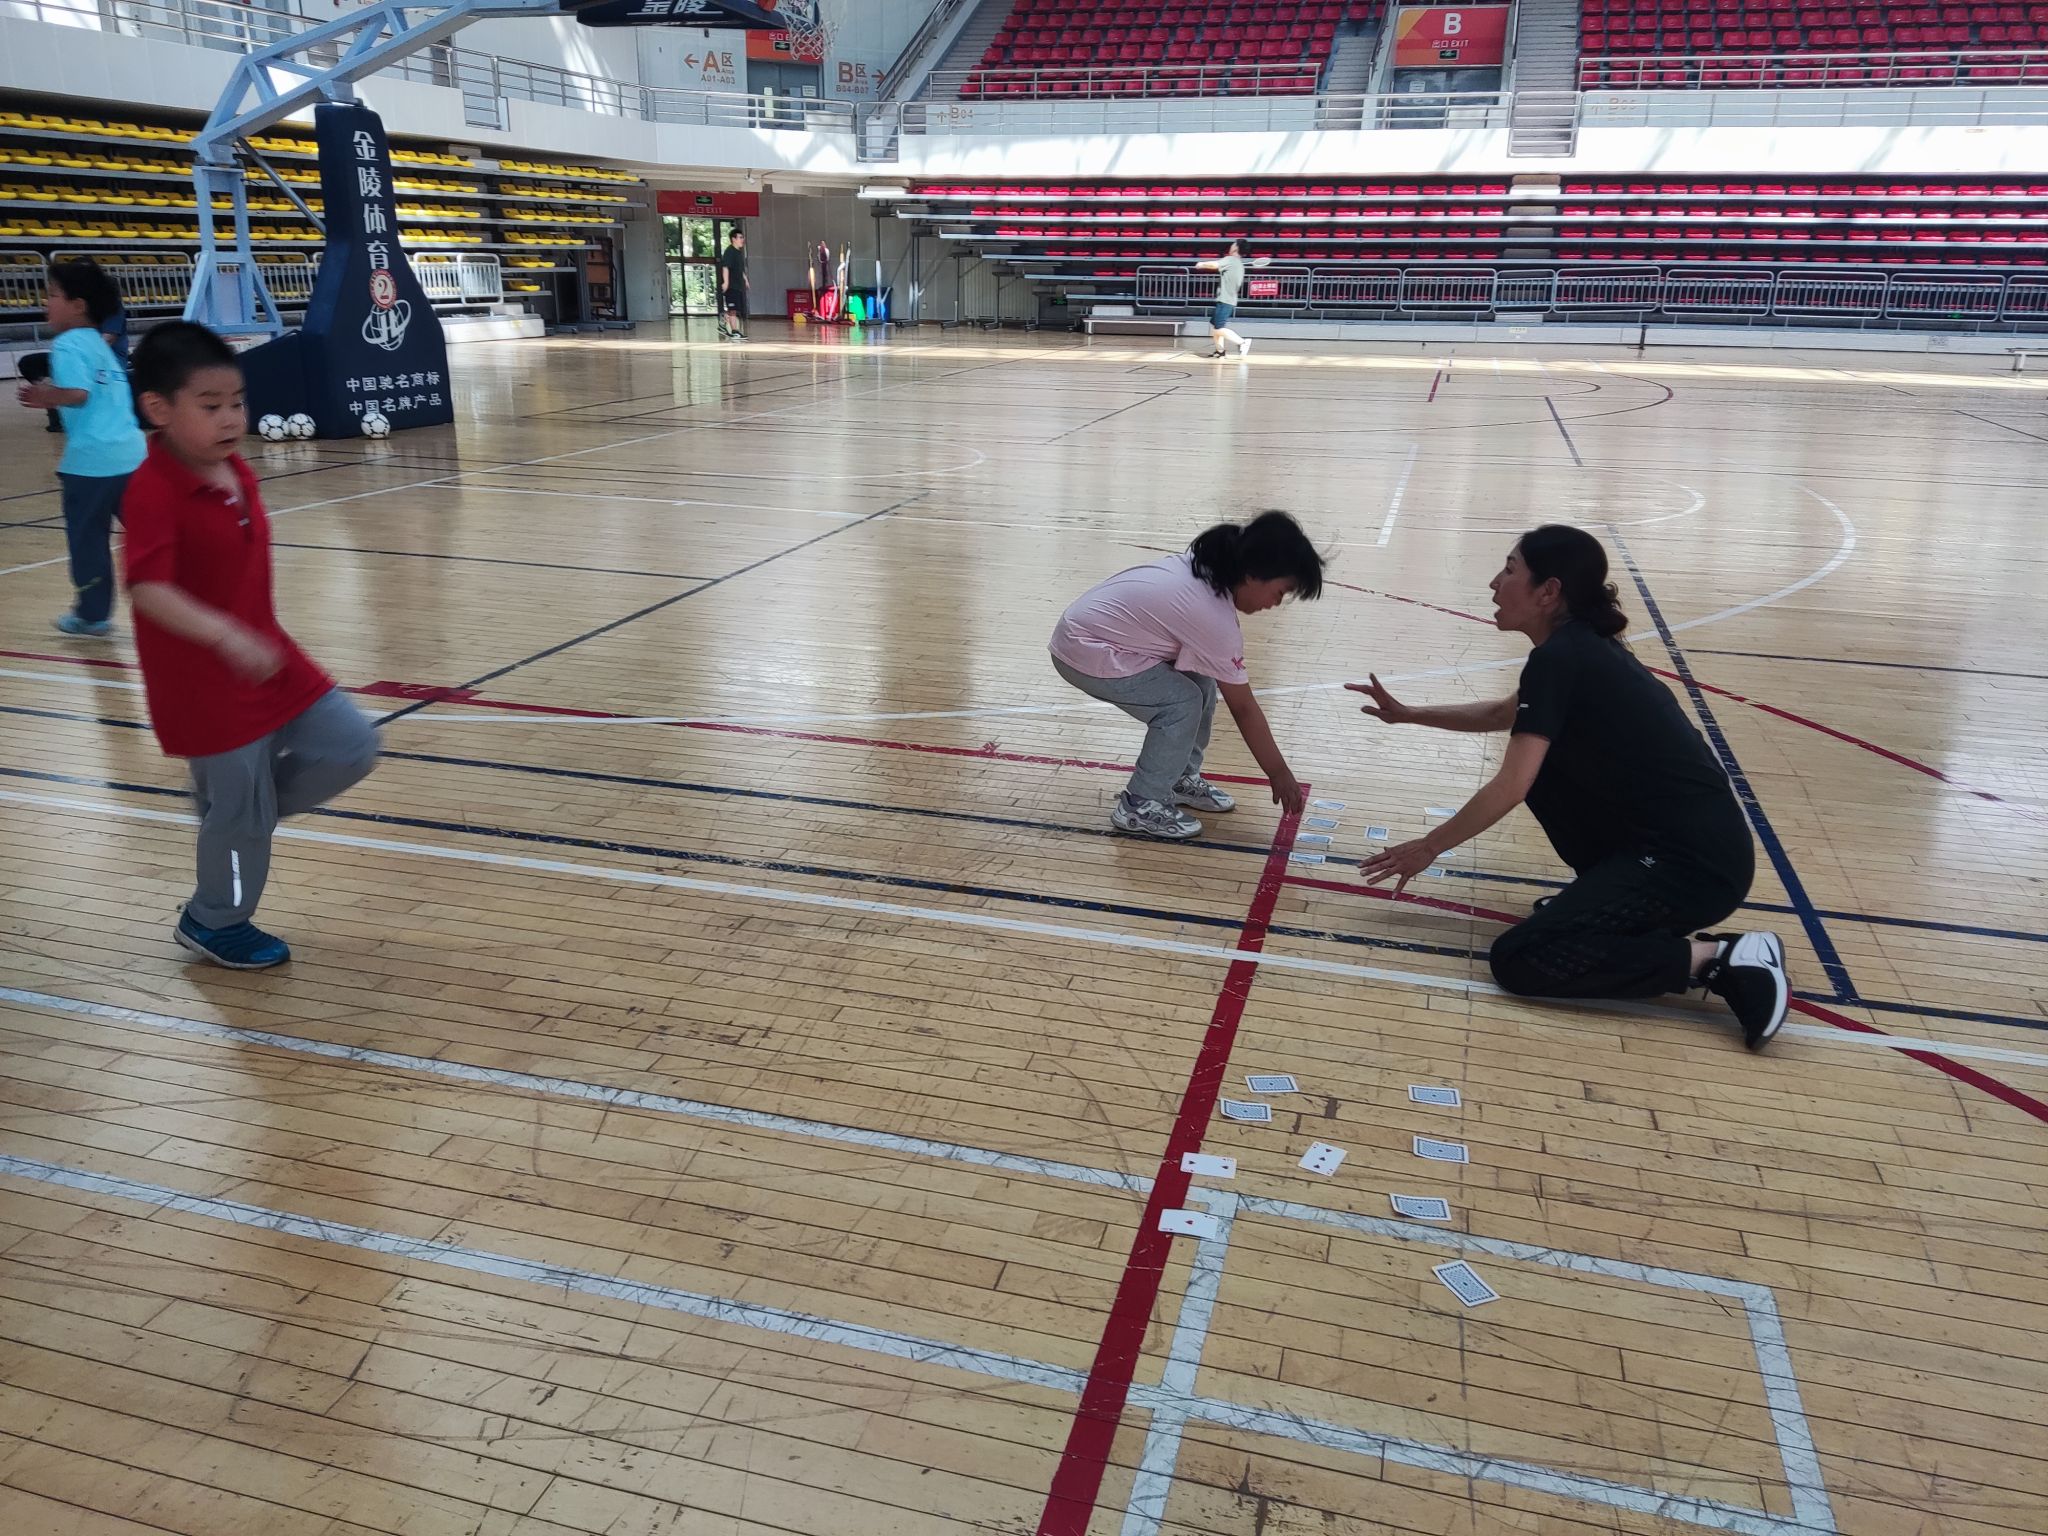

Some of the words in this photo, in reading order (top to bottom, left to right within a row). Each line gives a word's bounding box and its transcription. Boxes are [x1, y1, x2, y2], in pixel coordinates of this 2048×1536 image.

[1443, 12, 1462, 35] B
[1451, 39, 1469, 48] EXIT
[700, 74, 736, 84] A01-A03
[352, 130, 389, 270] 金陵体育
[346, 371, 440, 393] 中国驰名商标
[349, 393, 442, 415] 中国名牌产品
